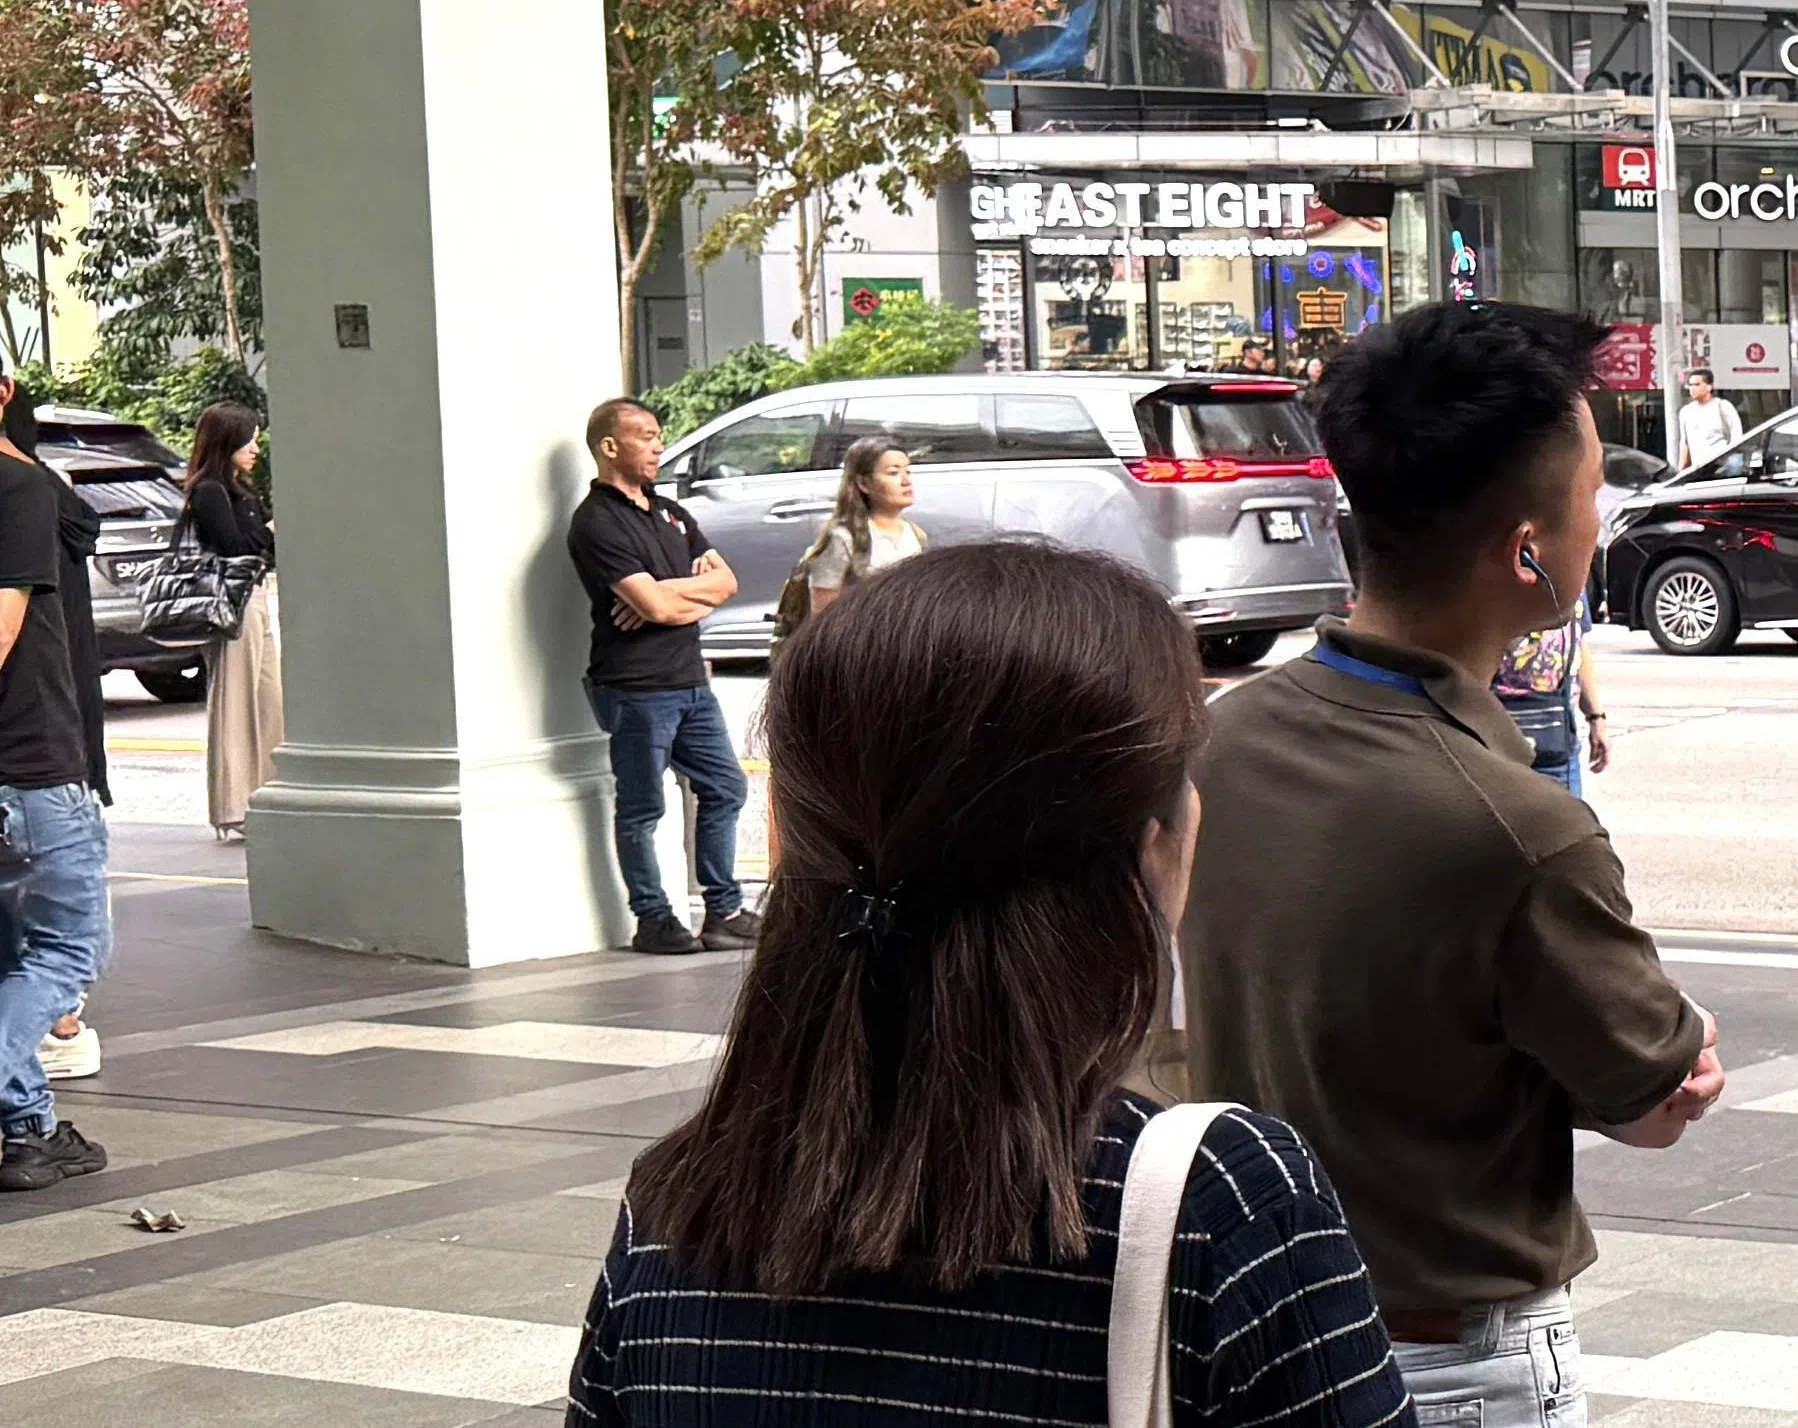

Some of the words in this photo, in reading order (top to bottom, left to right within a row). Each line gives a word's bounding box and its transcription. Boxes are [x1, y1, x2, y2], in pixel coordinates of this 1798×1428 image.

[1016, 182, 1150, 228] EAST
[1159, 182, 1315, 228] EIGHT
[1614, 189, 1656, 207] MRT
